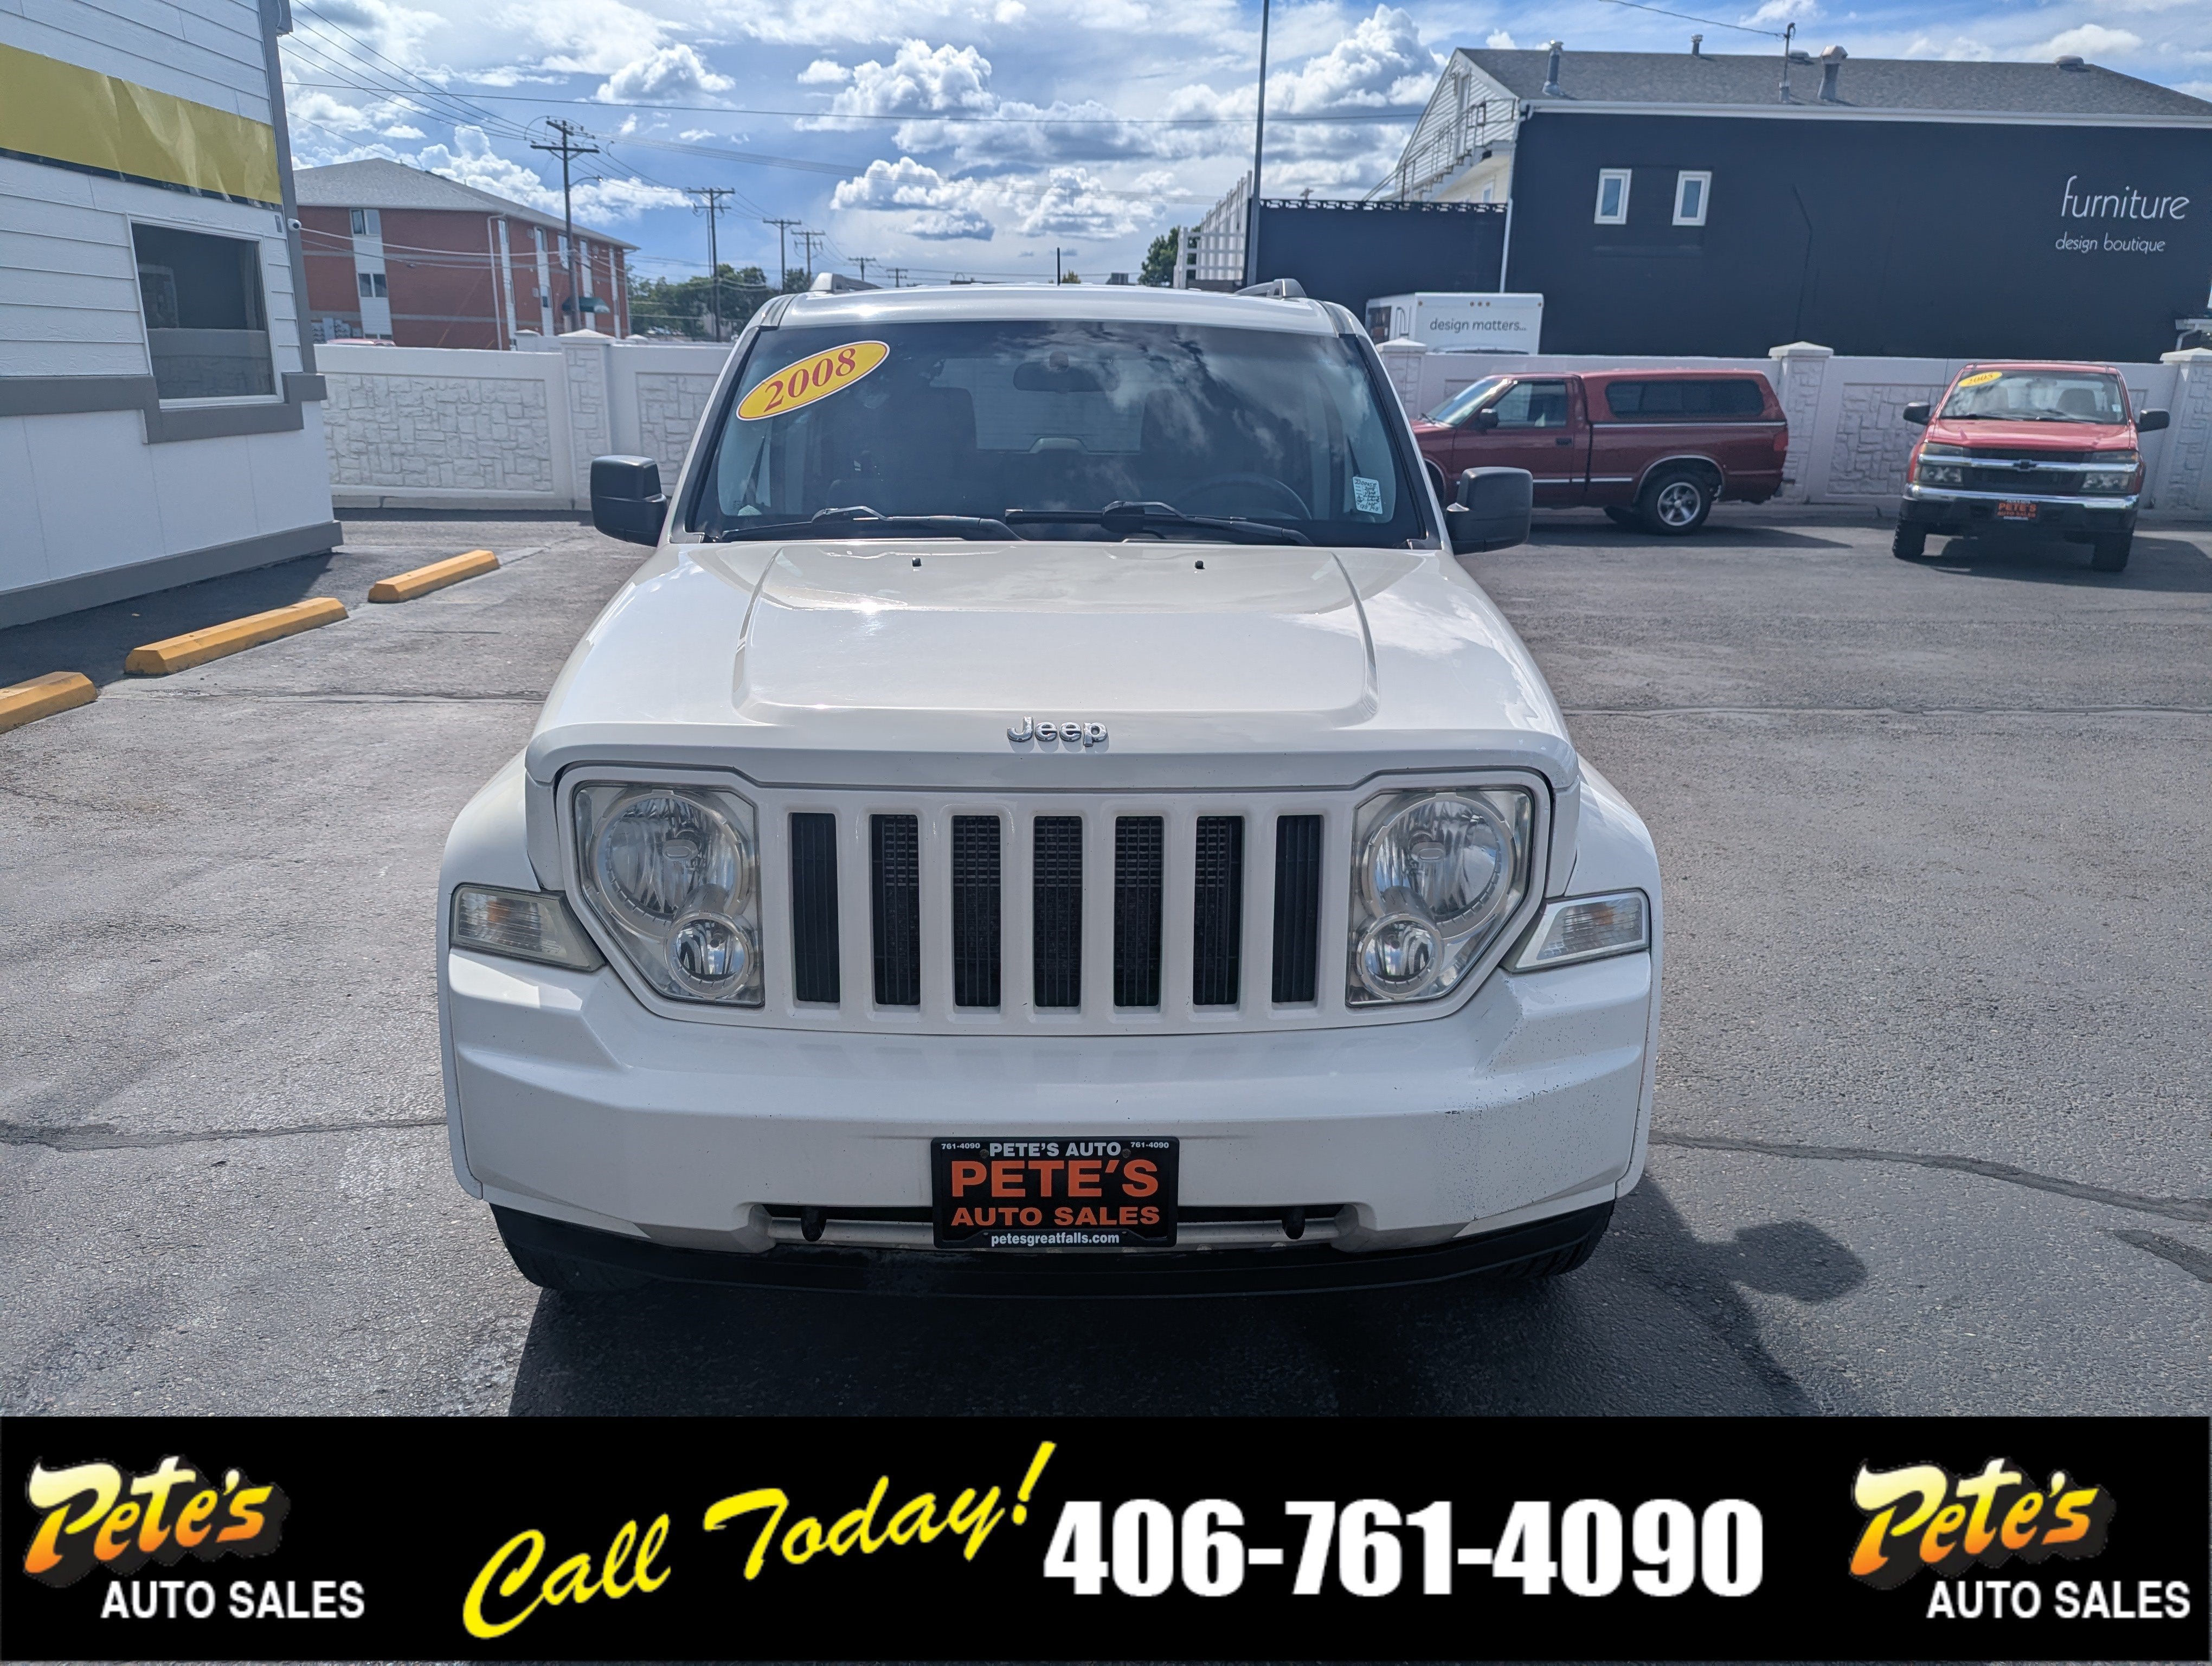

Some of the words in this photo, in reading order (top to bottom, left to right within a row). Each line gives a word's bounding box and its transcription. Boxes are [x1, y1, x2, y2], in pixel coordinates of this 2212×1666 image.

[2061, 175, 2190, 220] furniture
[2055, 231, 2098, 254] design
[2104, 232, 2166, 254] boutique
[1430, 318, 1469, 334] design
[1472, 319, 1527, 331] matters...
[763, 348, 856, 413] 2008
[1007, 716, 1108, 747] Jeep
[989, 1142, 1059, 1157] PETE'S
[1065, 1142, 1121, 1157] AUTO
[951, 1159, 1159, 1197] PETE'S
[950, 1207, 1043, 1226] AUTO
[1054, 1207, 1160, 1226] SALES
[991, 1232, 1120, 1246] petesgreatfalls.com
